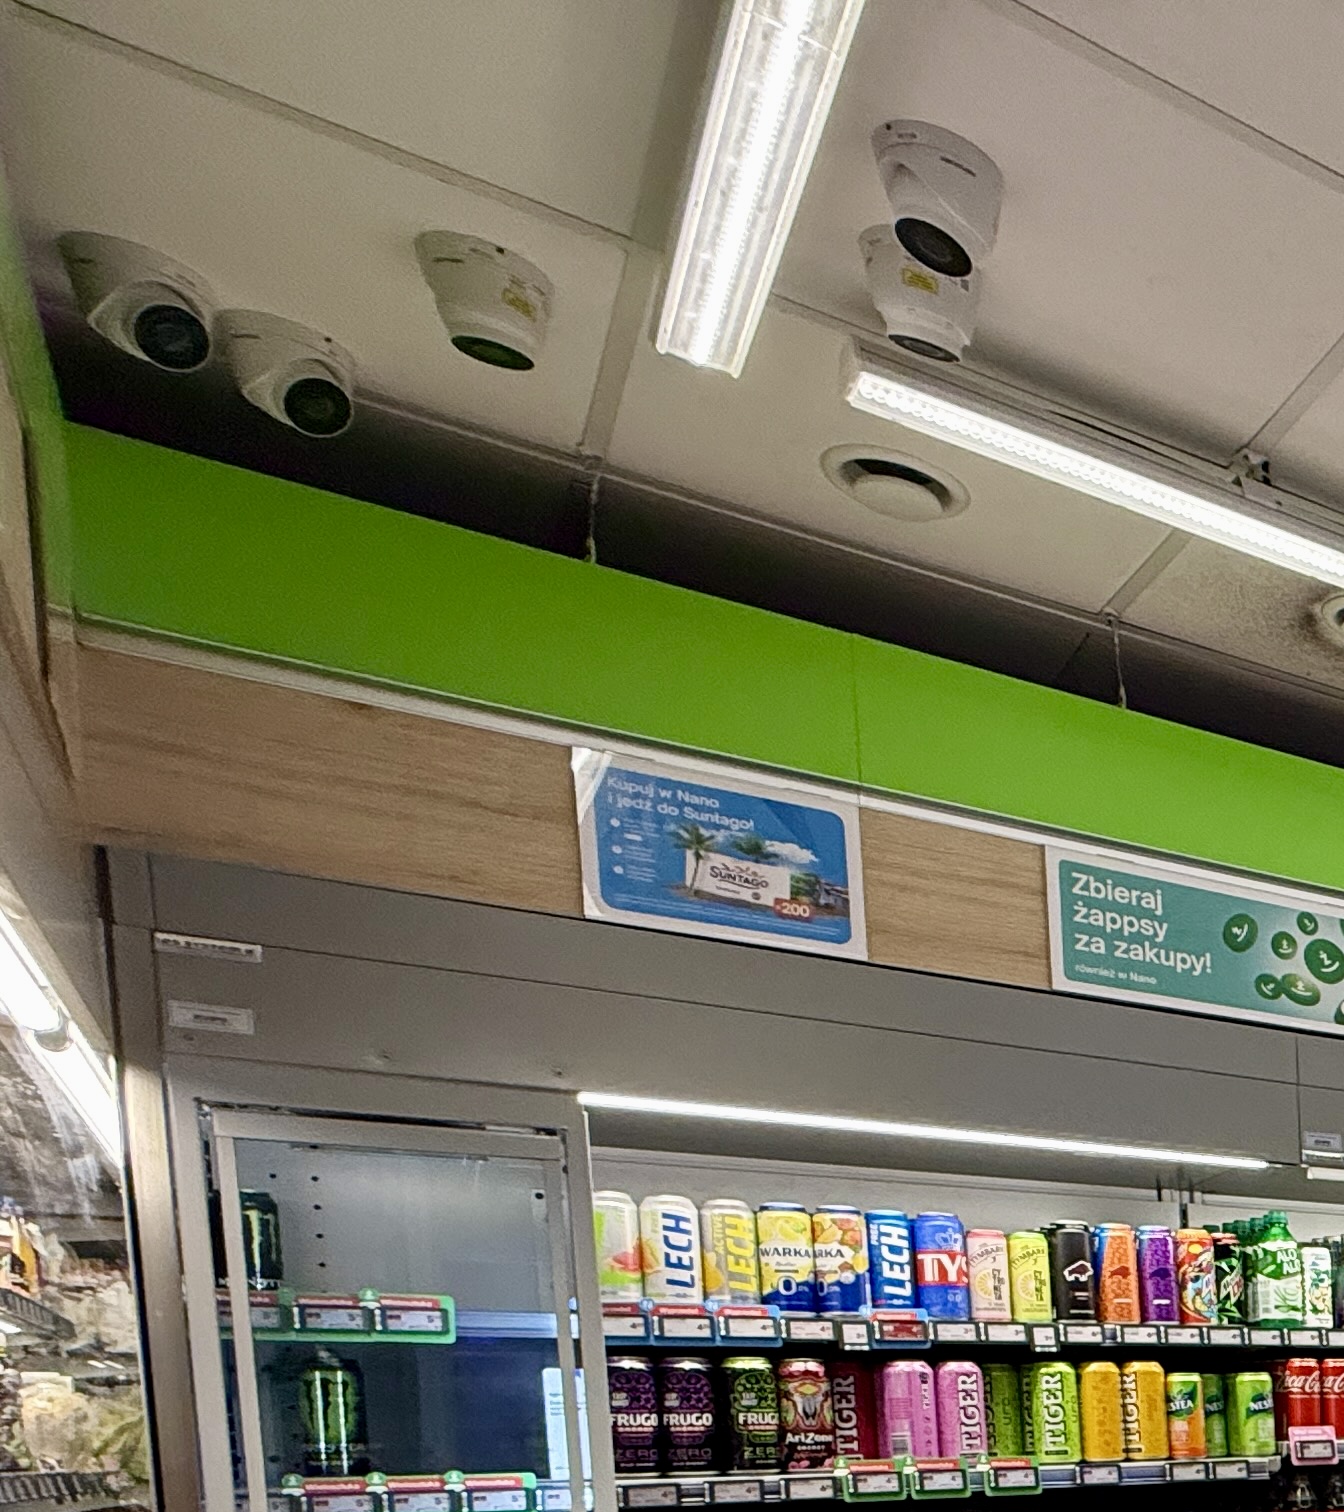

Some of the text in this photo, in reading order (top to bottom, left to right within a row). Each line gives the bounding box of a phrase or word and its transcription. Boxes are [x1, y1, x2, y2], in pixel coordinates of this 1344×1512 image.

[607, 777, 720, 808] Kupuj w Nano
[657, 803, 679, 816] do
[683, 806, 754, 831] Suntago!
[709, 864, 769, 889] SUNTAGO
[1071, 872, 1163, 914] Zbieraj
[1072, 901, 1168, 942] żappsy
[1074, 933, 1212, 976] za zakupy!
[1129, 972, 1157, 986] Nano
[662, 1212, 695, 1289] LECH
[724, 1215, 758, 1292] LECH
[879, 1223, 912, 1297] LECH
[663, 1413, 712, 1427] FRUGO
